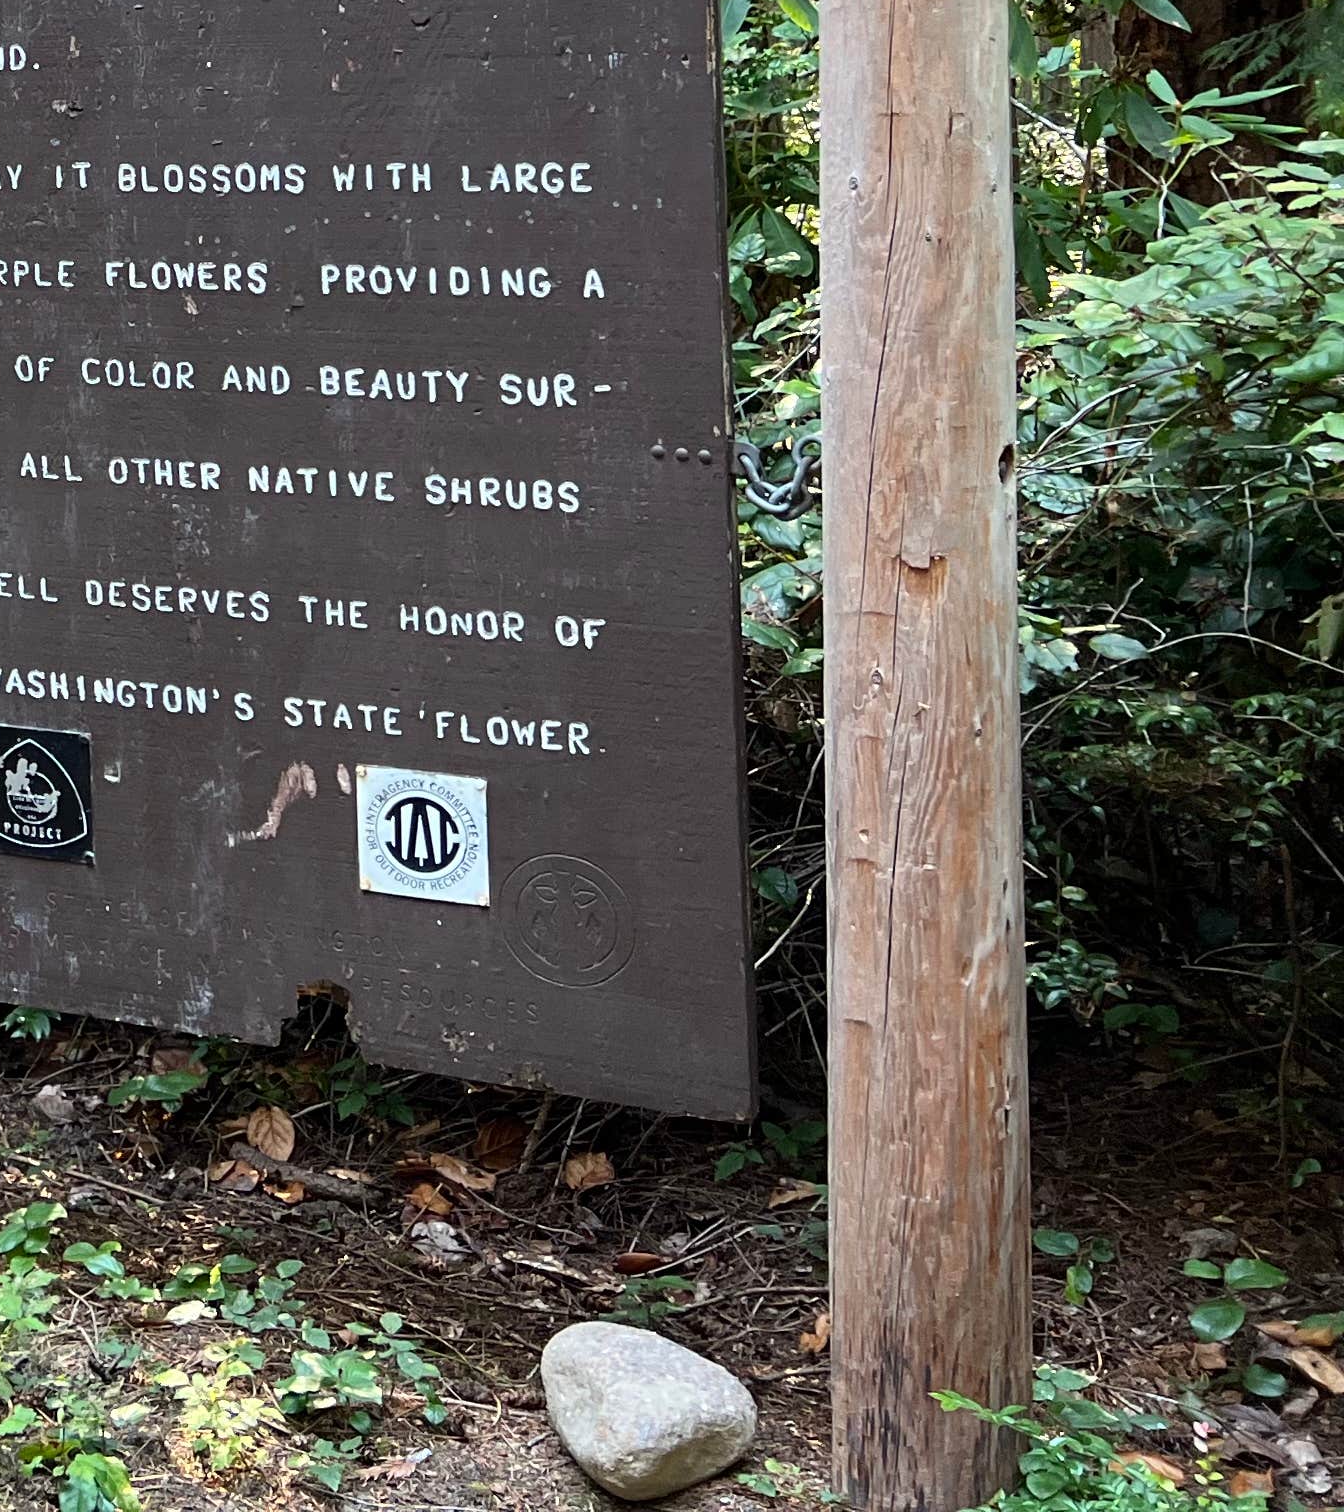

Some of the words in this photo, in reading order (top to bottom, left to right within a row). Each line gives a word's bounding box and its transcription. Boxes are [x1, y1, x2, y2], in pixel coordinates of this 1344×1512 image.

[55, 161, 91, 189] IT
[118, 162, 307, 194] BLOSSOMS
[332, 162, 432, 193] WITH
[461, 162, 593, 194] LARGE
[105, 261, 268, 294] FLOWERS
[321, 263, 552, 298] PROVIDING
[583, 268, 605, 299] A
[14, 354, 55, 382] OF
[81, 357, 195, 390] COLOR
[221, 364, 290, 395] AND
[319, 365, 469, 403] BEAUTY
[20, 452, 83, 482] ALL
[108, 457, 221, 490] OTHER
[248, 465, 395, 502] NATIVE
[424, 473, 580, 513] SHRUBS
[85, 579, 270, 622] DESERVES
[298, 595, 368, 629] THE
[400, 603, 525, 642] HONOR
[555, 615, 606, 650] OF
[283, 696, 402, 736] STATE
[3, 821, 62, 840] PROJECT
[365, 778, 425, 826] INTERAGENCY
[429, 782, 479, 838] COMMITTEE
[365, 829, 378, 850] FOR
[375, 854, 425, 890] OUTDOOR
[430, 844, 479, 890] RECREATION
